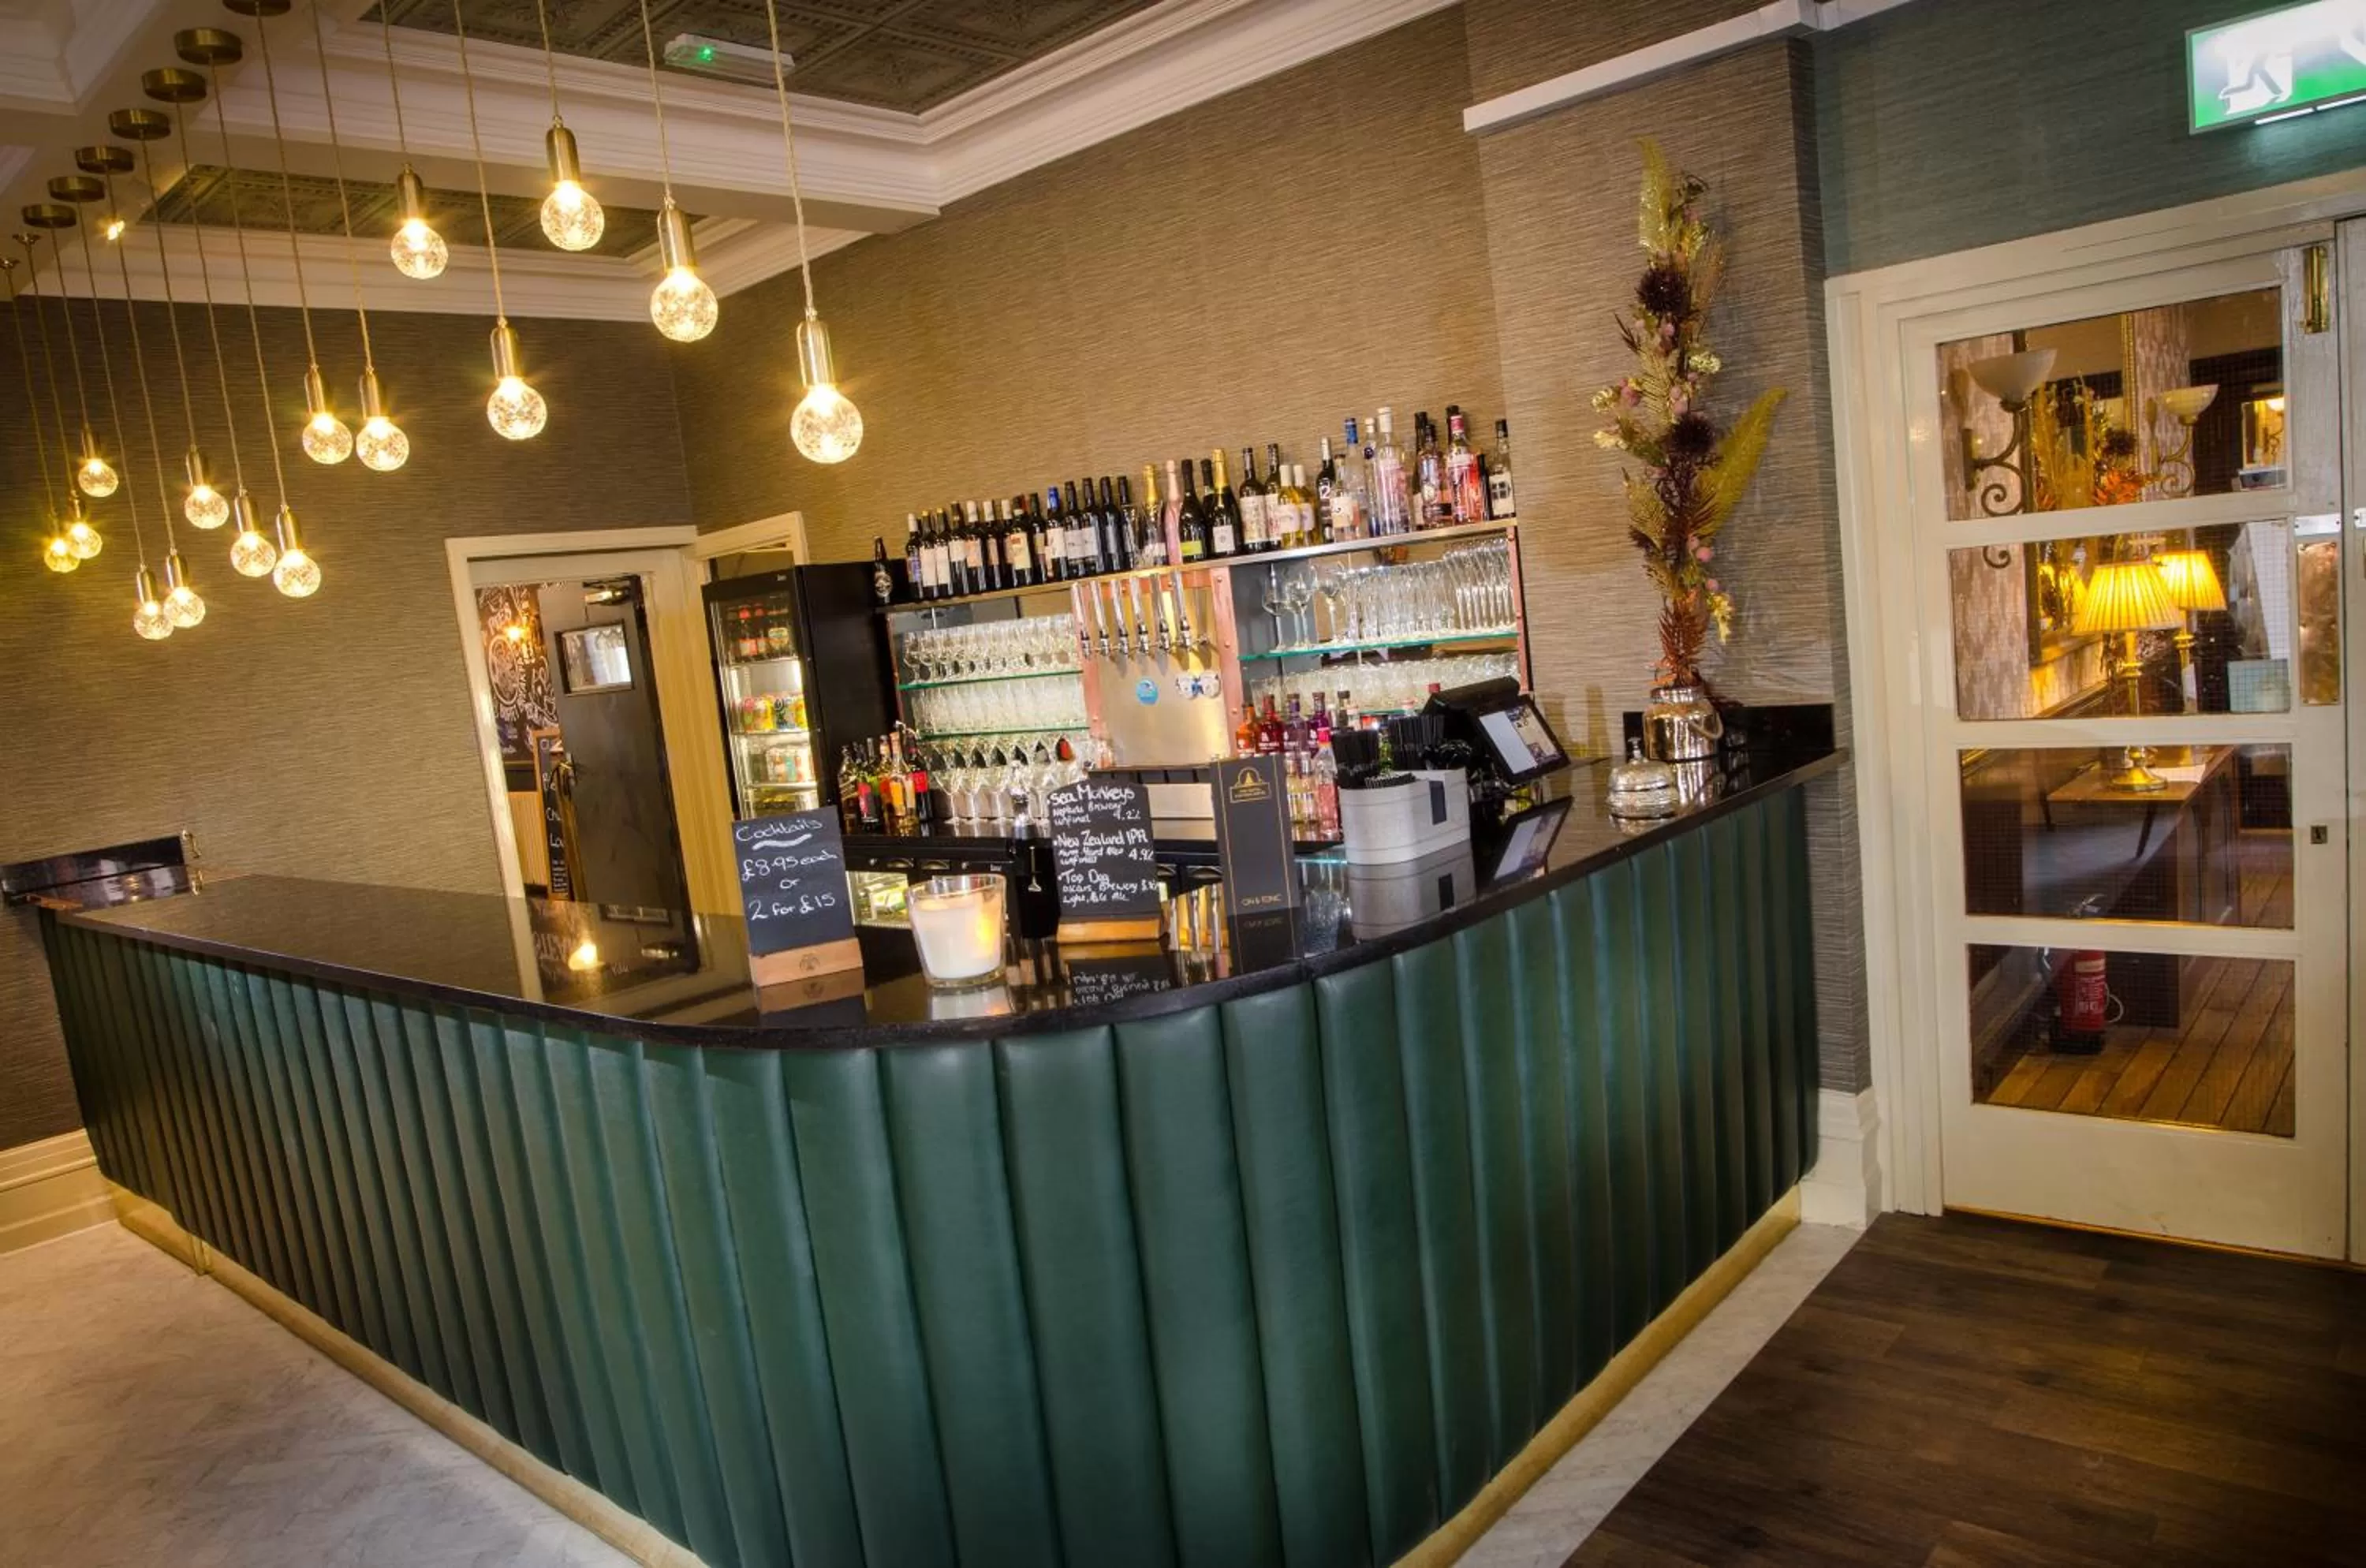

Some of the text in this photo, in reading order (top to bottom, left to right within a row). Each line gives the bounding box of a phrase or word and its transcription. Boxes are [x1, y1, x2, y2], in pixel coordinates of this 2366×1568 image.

[1050, 791, 1078, 805] Sea
[736, 818, 823, 842] Cocktails
[1057, 827, 1148, 848] New Zealand IPA
[742, 849, 838, 881] £8.95 each
[779, 878, 800, 890] or
[1060, 868, 1110, 884] Top Dog
[748, 892, 836, 921] 2 for £15
